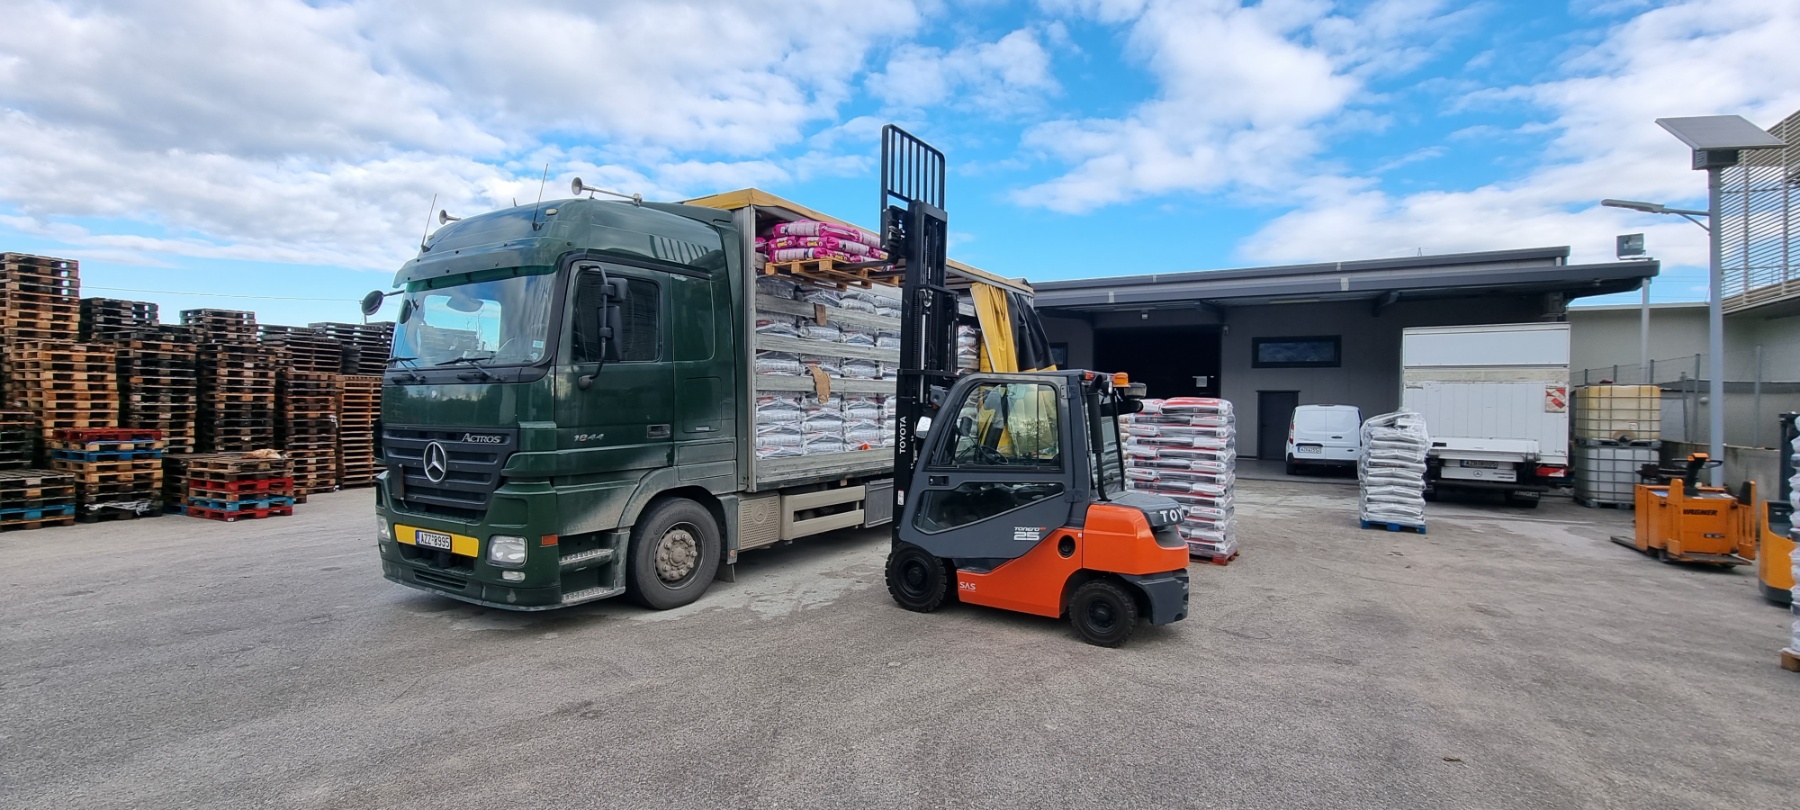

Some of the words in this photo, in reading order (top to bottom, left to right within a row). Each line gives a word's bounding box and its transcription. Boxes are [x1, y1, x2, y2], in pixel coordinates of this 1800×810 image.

[461, 432, 501, 443] ACTROS
[574, 433, 605, 442] 1844
[899, 416, 907, 455] TOYOTA
[1160, 508, 1183, 523] TOY
[1013, 531, 1040, 541] 25
[960, 581, 976, 591] SAS
